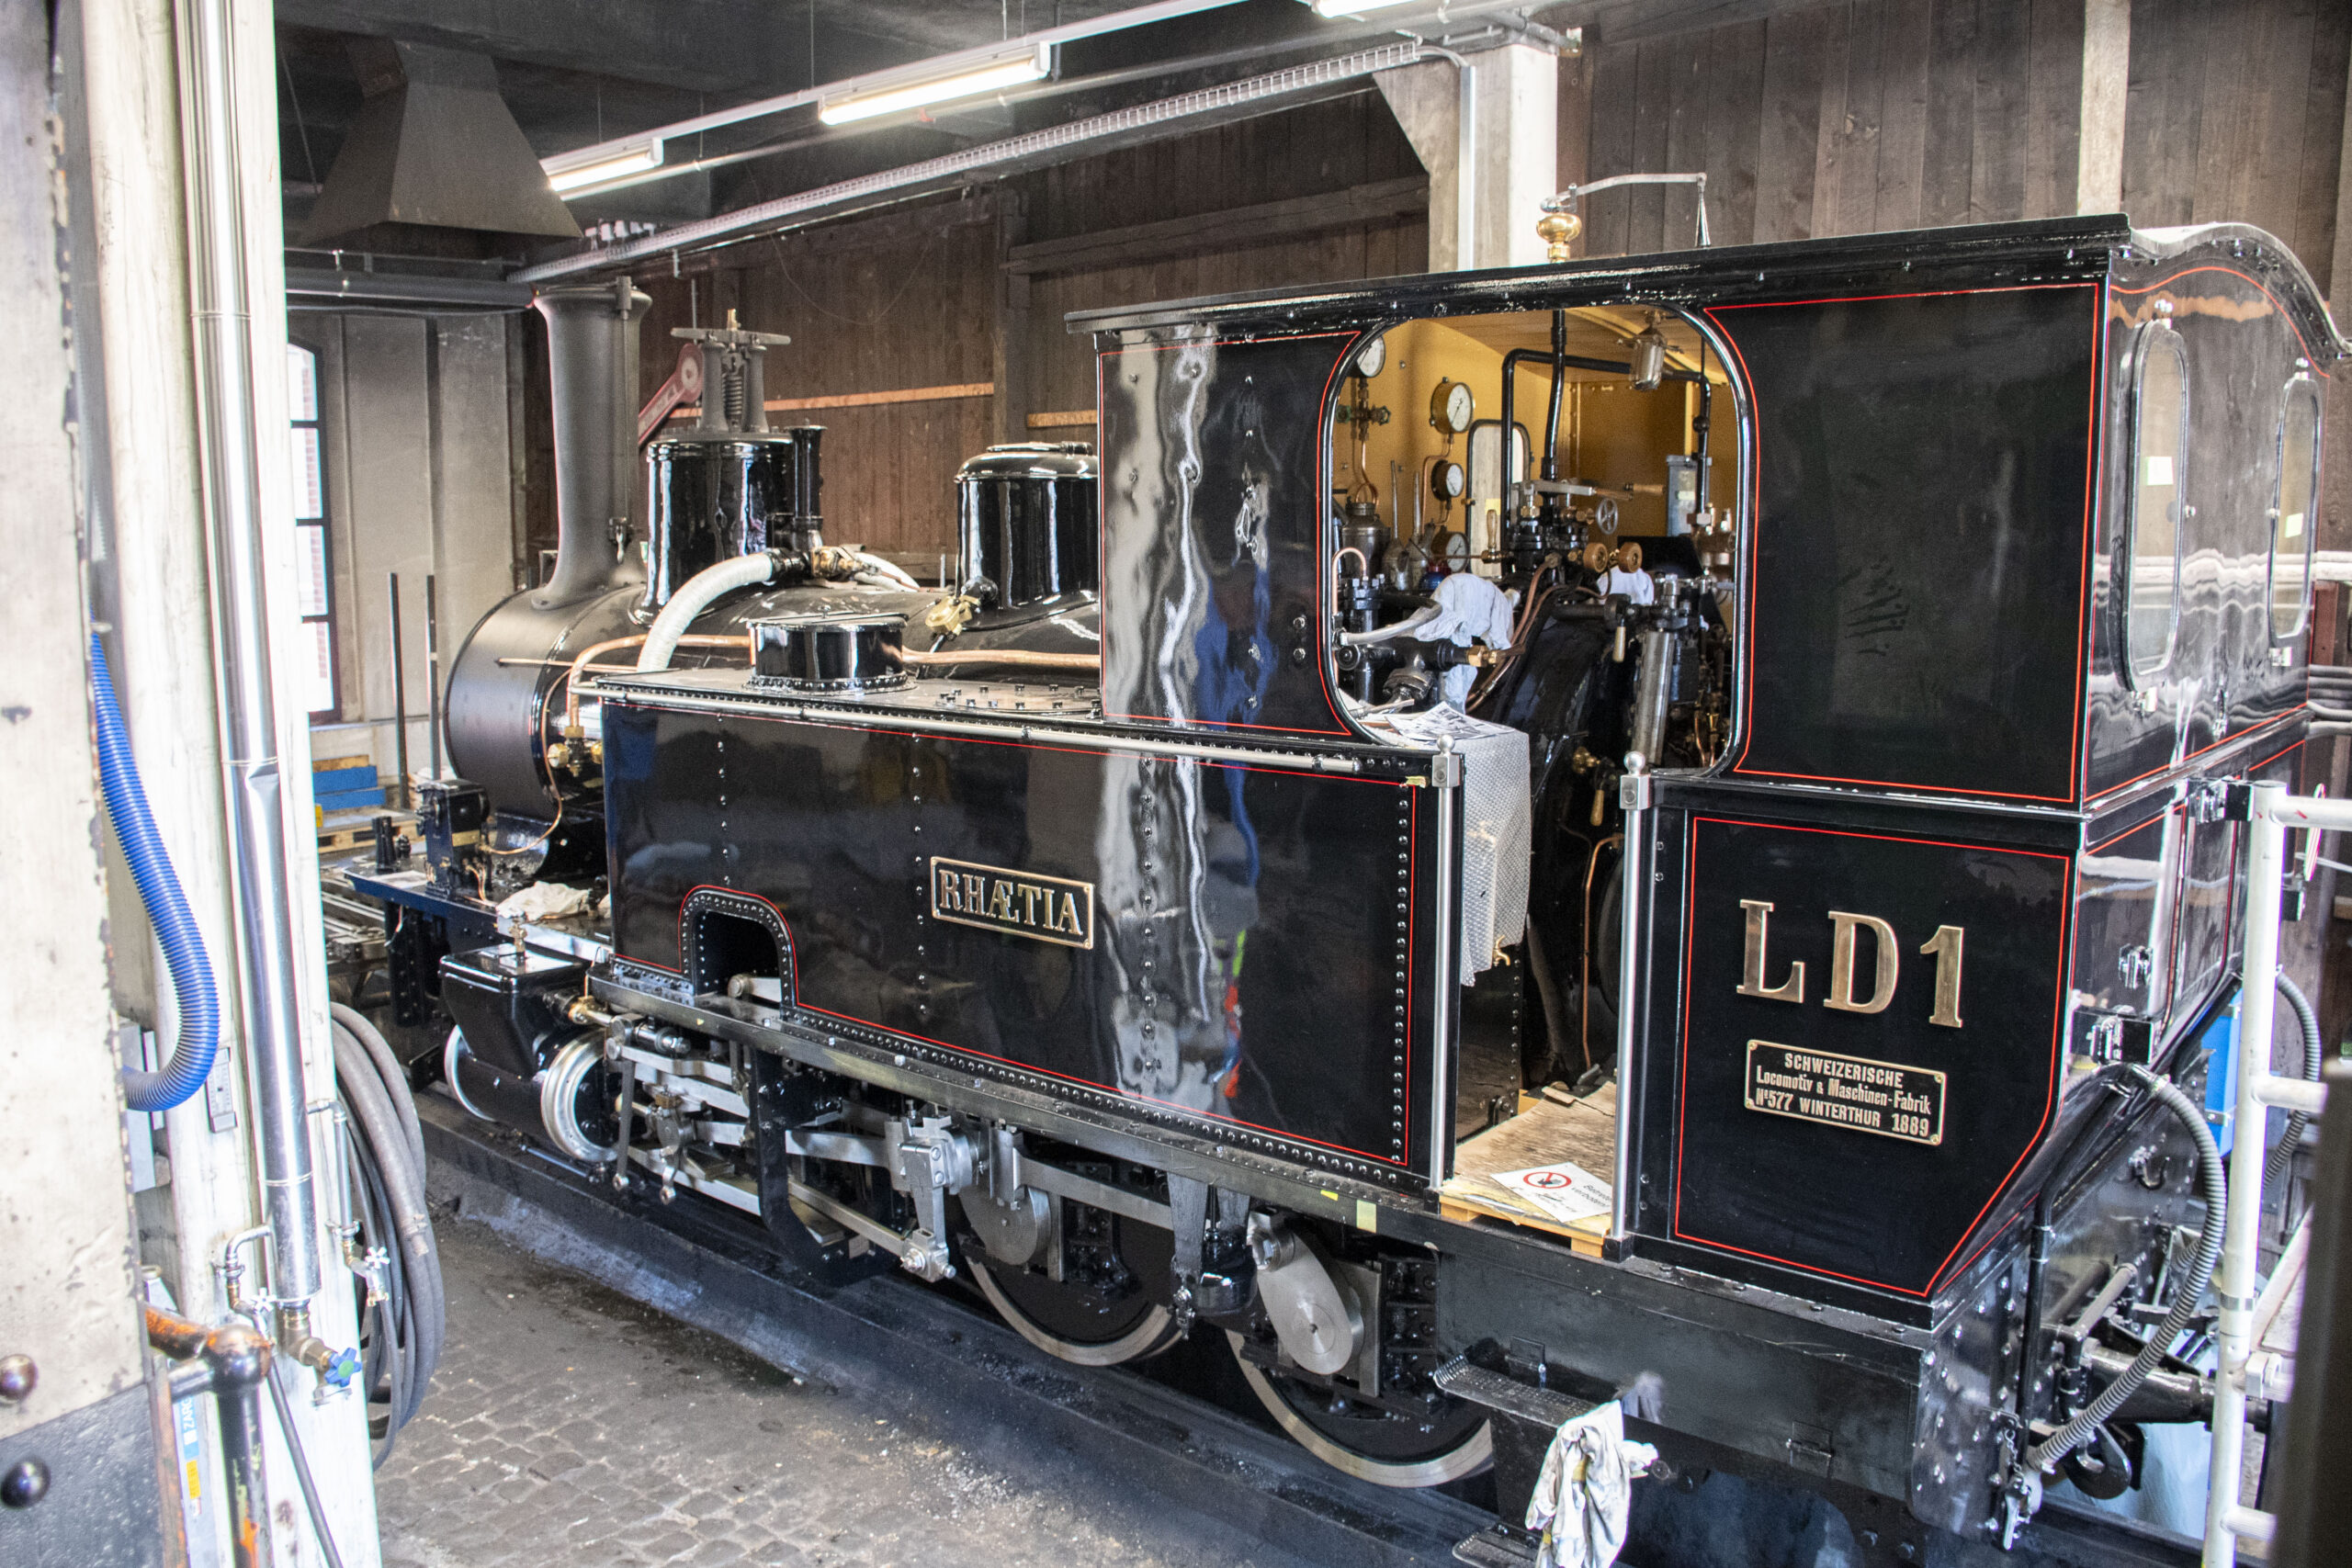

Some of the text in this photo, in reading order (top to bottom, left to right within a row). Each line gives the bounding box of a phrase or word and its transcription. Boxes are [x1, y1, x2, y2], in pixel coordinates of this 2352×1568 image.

[939, 869, 1084, 936] RHÆTIA
[1756, 1065, 1931, 1114] Locomotiv & Maschinen-Fabrik
[1784, 1053, 1904, 1089] SCHWEIZERISCHE
[1799, 1097, 1881, 1127] WINTERTHUR
[1891, 1112, 1929, 1137] 1889
